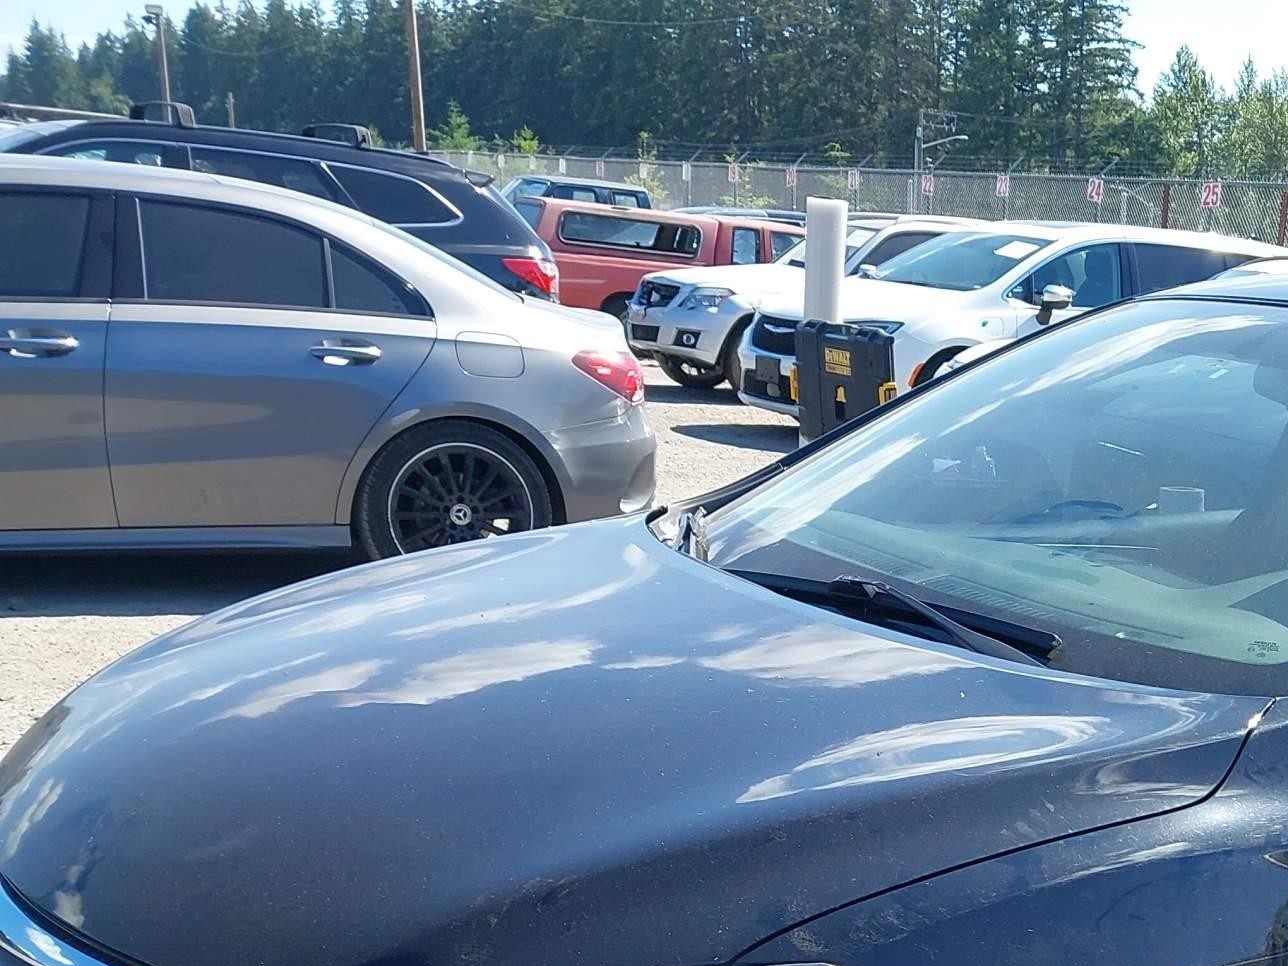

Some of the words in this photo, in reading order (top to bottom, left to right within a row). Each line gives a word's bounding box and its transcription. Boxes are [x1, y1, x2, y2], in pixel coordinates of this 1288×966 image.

[923, 176, 932, 195] 22
[998, 177, 1008, 196] 23
[1088, 179, 1102, 201] 24
[1203, 183, 1219, 206] 25
